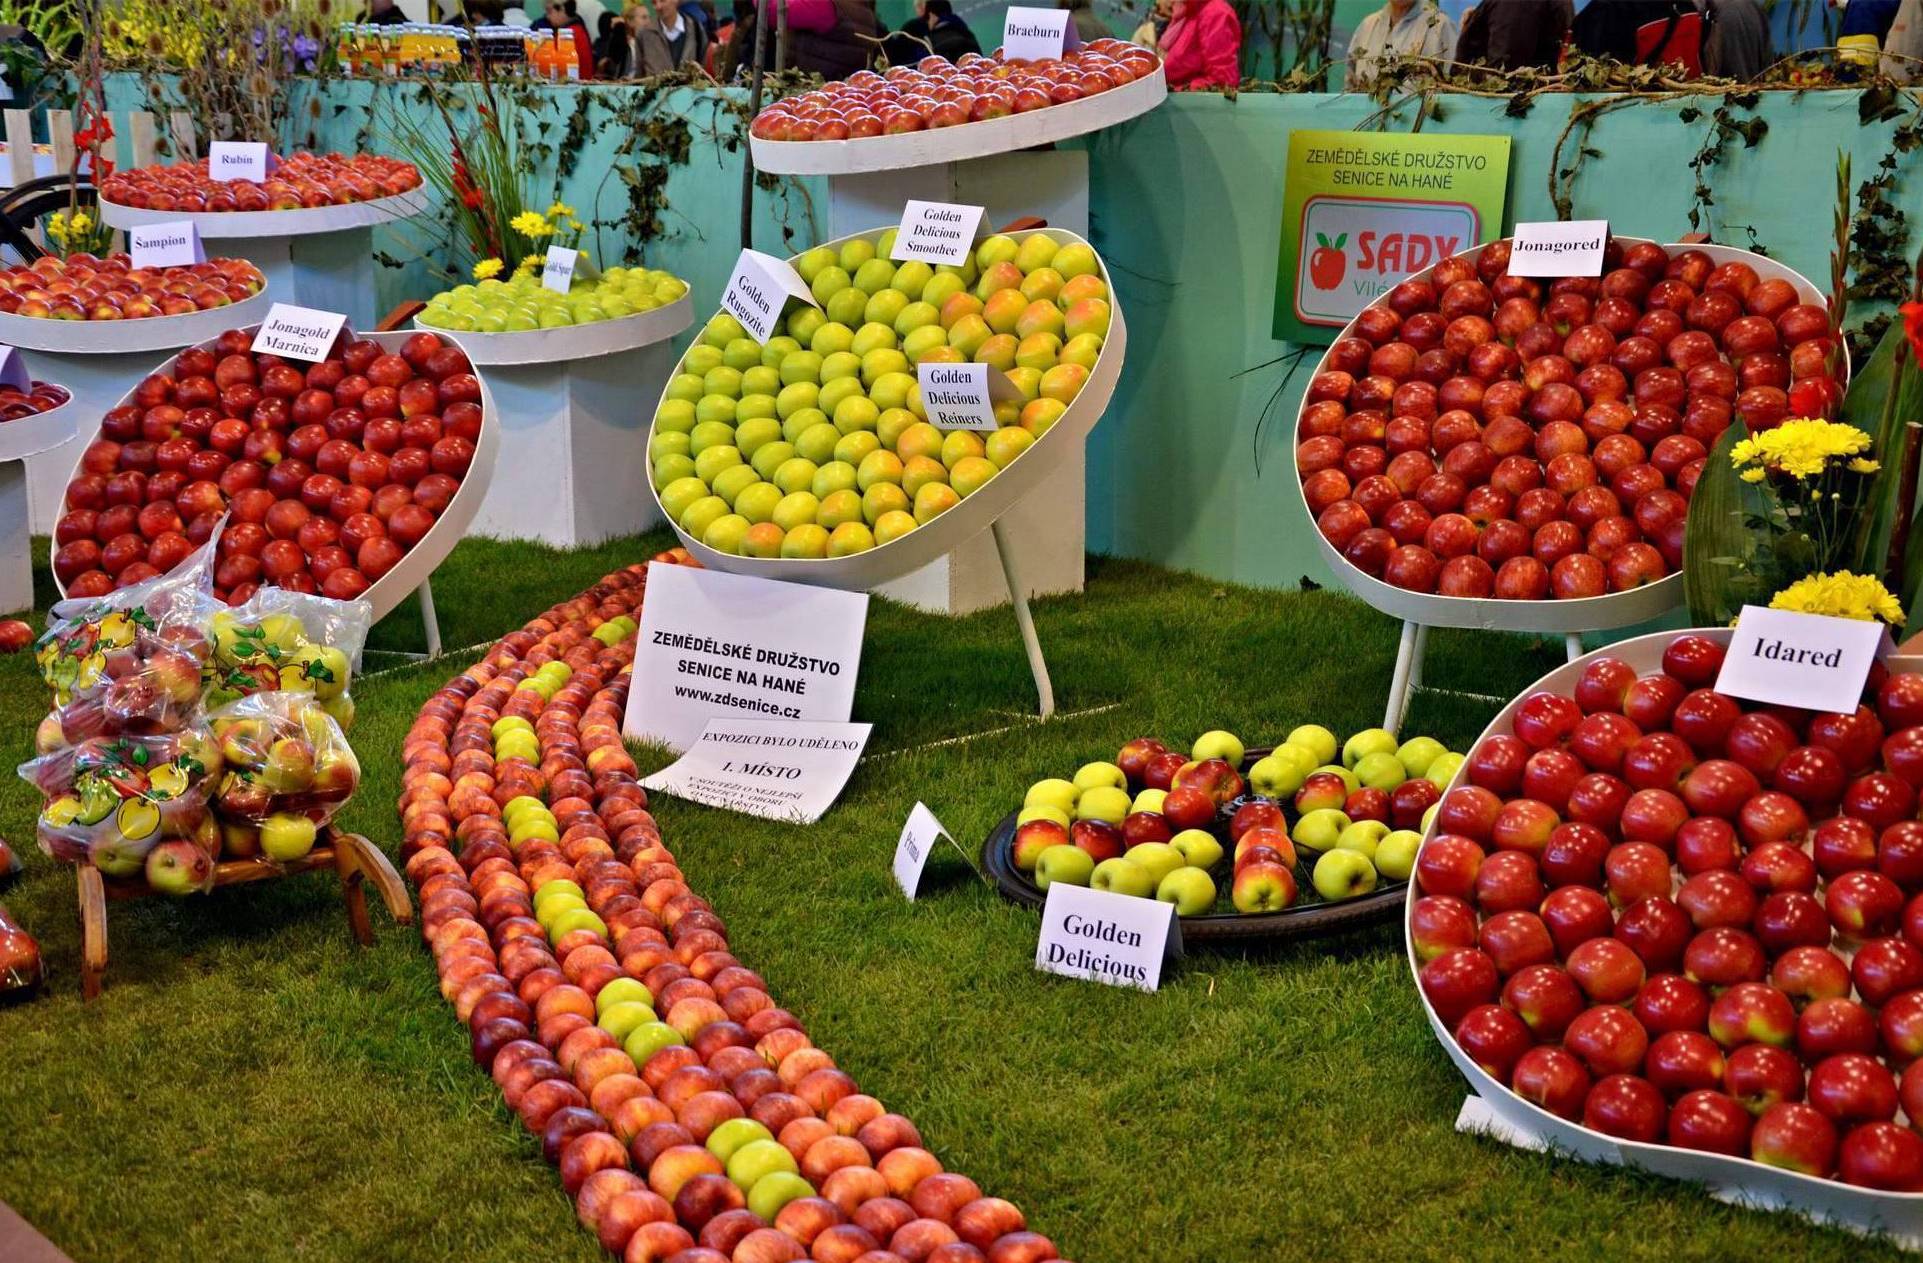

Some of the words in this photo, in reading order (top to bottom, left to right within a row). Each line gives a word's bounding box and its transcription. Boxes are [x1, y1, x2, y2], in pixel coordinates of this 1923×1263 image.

[1008, 23, 1060, 38] Braeburn
[1306, 148, 1400, 168] ZEMĚDĚLSKÉ
[1404, 151, 1487, 171] DRUŽSTVO
[1332, 170, 1385, 186] SENICE
[1389, 174, 1409, 187] NA
[1412, 173, 1453, 190] HANÉ
[923, 208, 962, 223] Golden
[913, 224, 962, 240] Delicious
[135, 236, 187, 249] Šampion
[905, 240, 958, 256] Smoothee
[1514, 238, 1600, 254] Jonagored
[1357, 231, 1459, 276] SADY
[738, 275, 770, 315] Golden
[726, 290, 765, 337] Rugozite
[268, 319, 331, 339] Jonagold
[263, 336, 320, 356] Marnica
[931, 369, 972, 384] Golden
[928, 391, 981, 405] Delicious
[938, 411, 984, 425] Reiners
[653, 630, 752, 661] ZEMĚDĚLSKÉ
[756, 648, 840, 676] DRUŽSTVO
[1753, 637, 1843, 668] Idared
[677, 659, 733, 681] SENICE
[736, 670, 758, 686] NA
[762, 675, 806, 695] HANÉ
[675, 685, 801, 719] www.zdsenice.cz
[702, 732, 759, 746] EXPOZICI
[762, 736, 797, 748] BYLO
[799, 737, 859, 751] UDĚLENO
[738, 761, 802, 780] MÍSTO
[904, 831, 920, 863] Prima
[1063, 914, 1142, 947] Golden
[1048, 943, 1147, 981] Delicious
